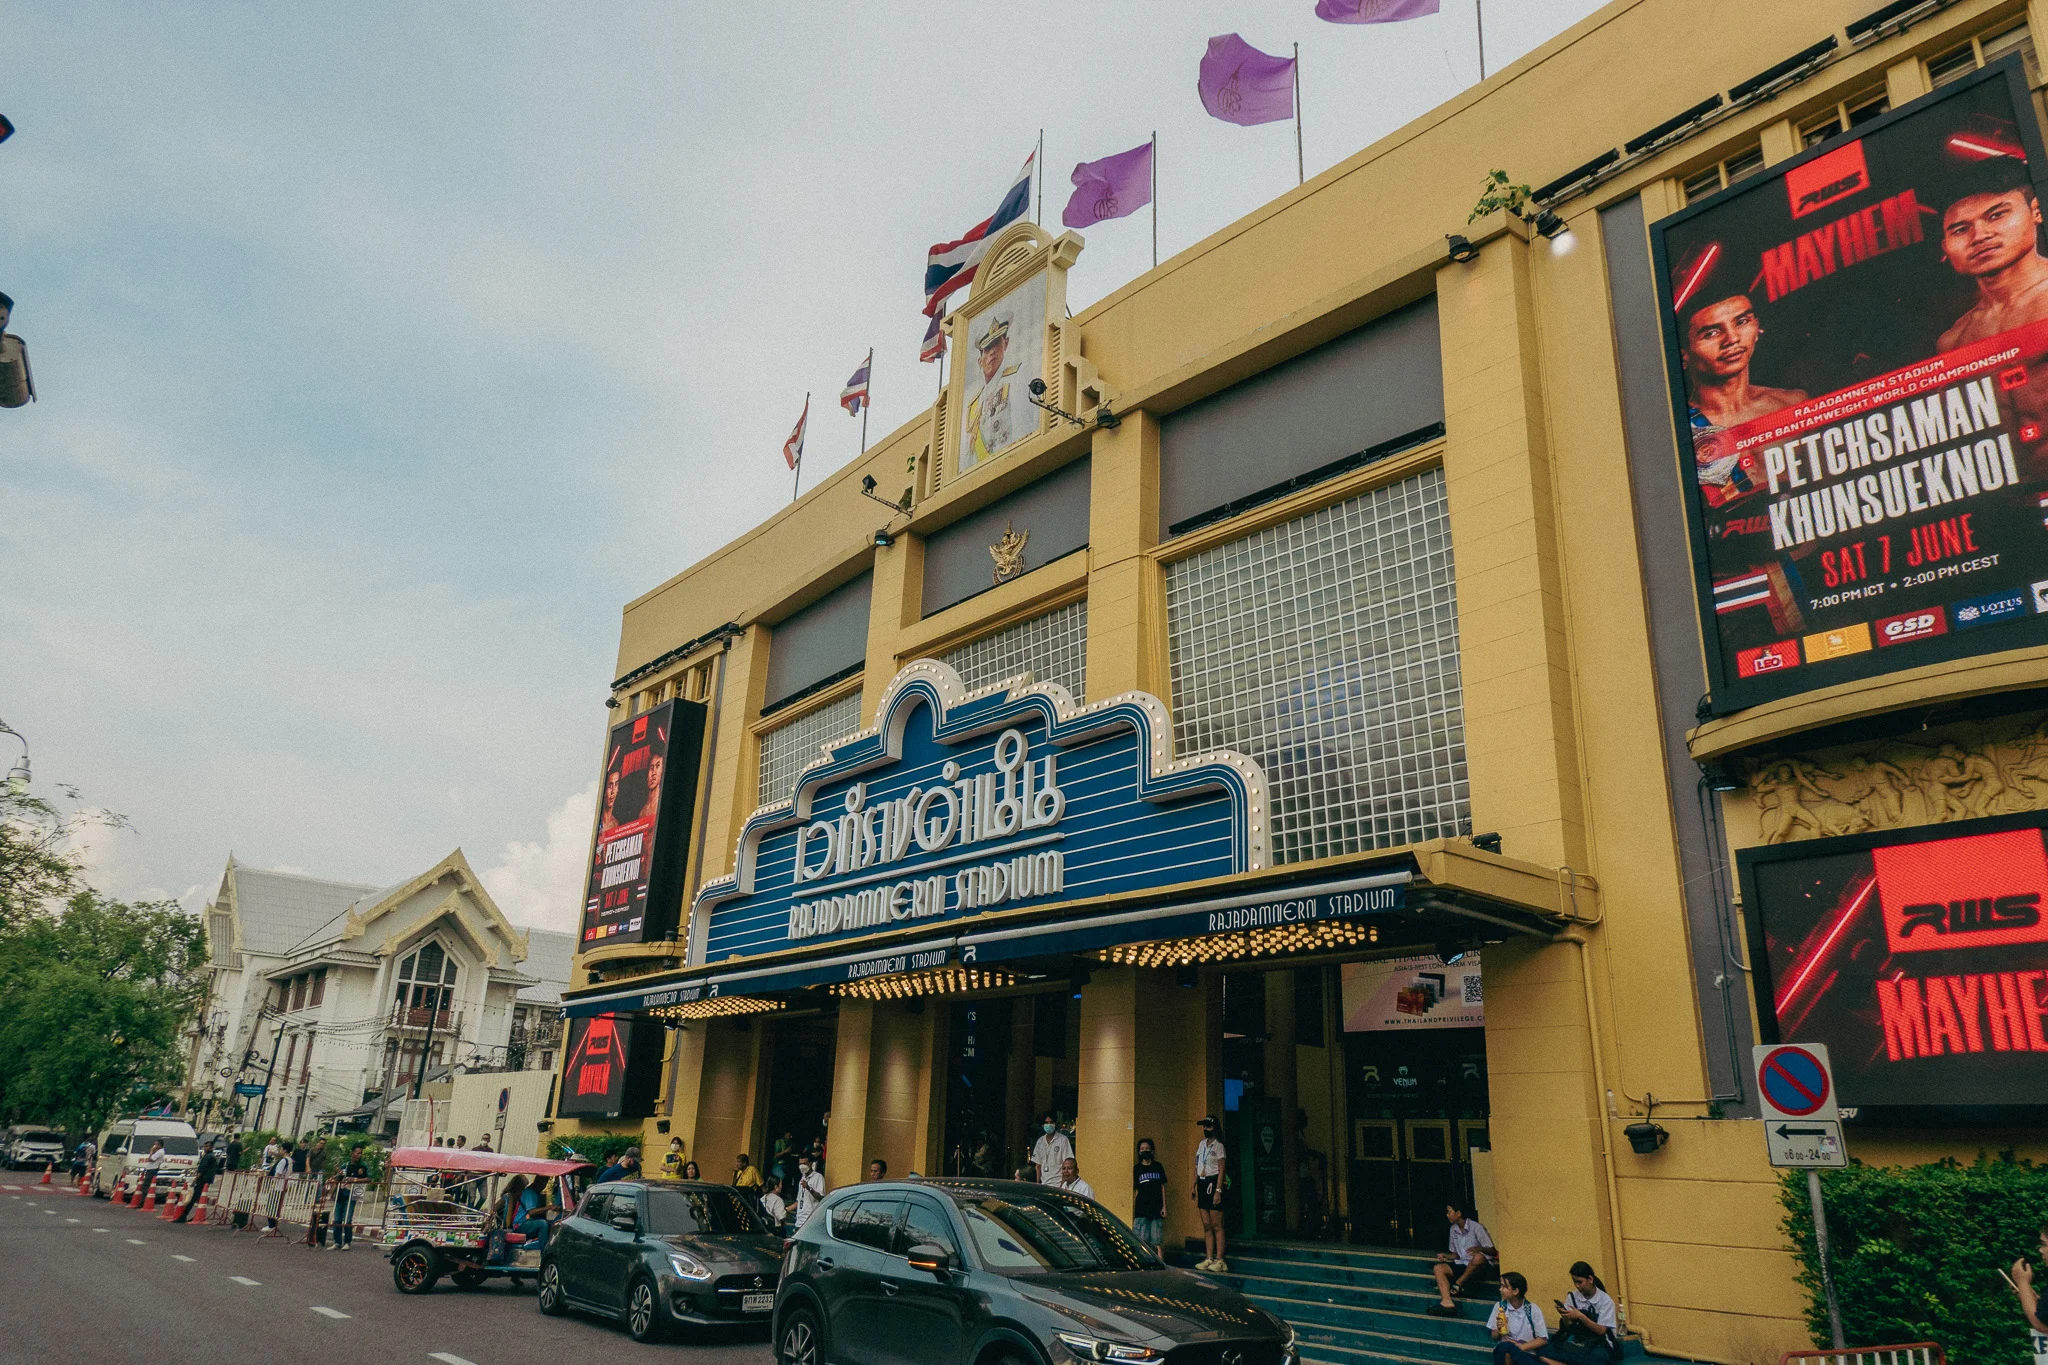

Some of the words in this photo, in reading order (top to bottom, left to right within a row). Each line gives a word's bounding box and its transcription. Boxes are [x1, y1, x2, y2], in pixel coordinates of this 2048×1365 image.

[1760, 189, 1925, 303] MAYHEM
[1736, 431, 1774, 451] SUPER
[1774, 398, 1870, 437] BANTAMWEIGHT
[1871, 383, 1917, 405] WORLD
[1919, 347, 2021, 389] CHAMPIONSHIP
[1794, 377, 1886, 419] RAJADAMNERN
[1887, 359, 1945, 386] STADIUM
[1763, 376, 2001, 495] PETCHSAMAN
[2025, 427, 2034, 438] 3
[1742, 457, 1751, 467] C
[1768, 434, 2020, 550] KHUNSUEKNOI
[1821, 542, 1868, 588] SAT
[1878, 536, 1891, 573] 7
[1907, 513, 1980, 567] JUNE
[1810, 594, 1840, 610] 7:00
[1841, 588, 1862, 603] PM
[1864, 582, 1886, 598] ICT
[1903, 571, 1936, 588] 2:00
[1938, 564, 1960, 579] PM
[1961, 553, 2001, 574] CEST
[1885, 614, 1936, 636] GSD
[1980, 596, 2023, 613] LOTUS
[1757, 656, 1782, 672] LEO
[787, 874, 947, 940] RAJADAMNERN
[955, 850, 1065, 910] STADIUM
[1208, 899, 1317, 931] RAJADAMNERN
[1329, 888, 1395, 915] STADIUM
[1902, 893, 2041, 938] RWS
[848, 956, 907, 978] RAJADAMNERN
[911, 950, 946, 969] STADIUM
[1392, 1077, 1418, 1088] VENUM
